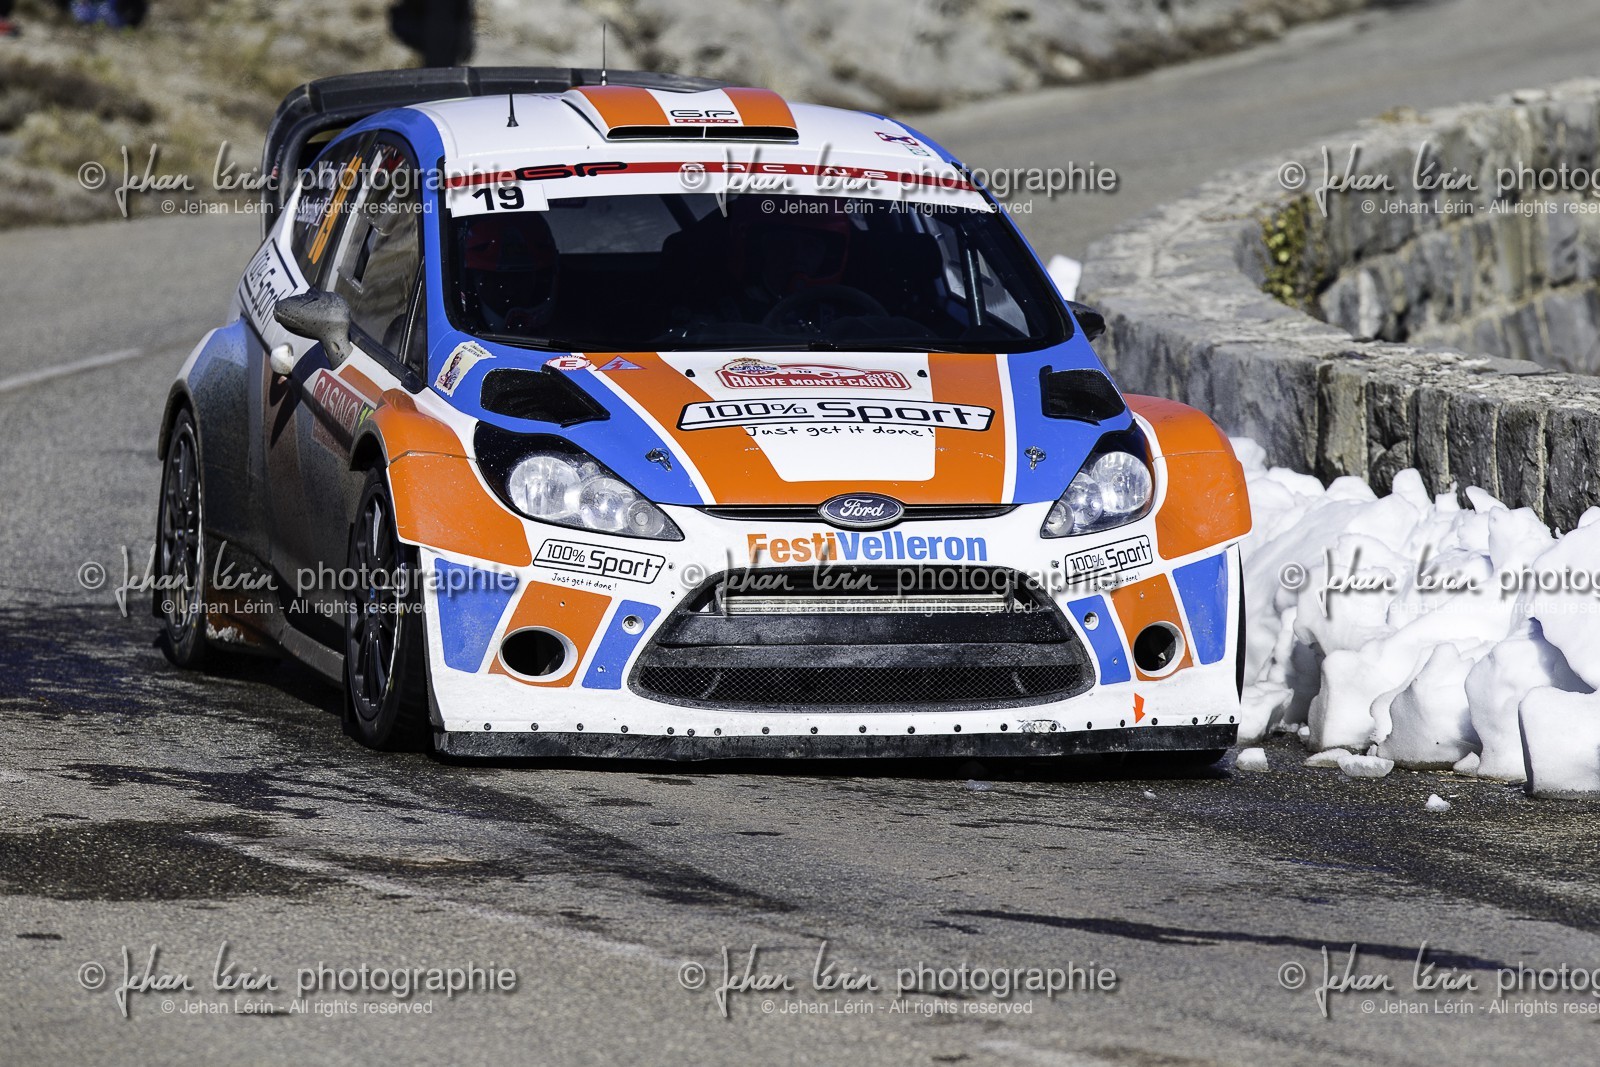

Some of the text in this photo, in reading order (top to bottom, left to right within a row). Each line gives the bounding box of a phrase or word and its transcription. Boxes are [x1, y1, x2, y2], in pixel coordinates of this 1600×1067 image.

[515, 161, 628, 181] GP
[472, 186, 525, 211] 19
[728, 375, 787, 387] RALLYE
[313, 376, 362, 437] CASINO
[699, 401, 973, 424] 100% Sport
[746, 426, 799, 437] Just
[806, 426, 842, 436] get
[849, 426, 865, 434] it
[839, 499, 885, 518] Ford
[746, 531, 988, 563] FestiVelleron
[1070, 541, 1148, 573] 100% Sport
[546, 543, 653, 578] 100% Sport
[551, 572, 570, 583] Just
[571, 578, 584, 587] get
